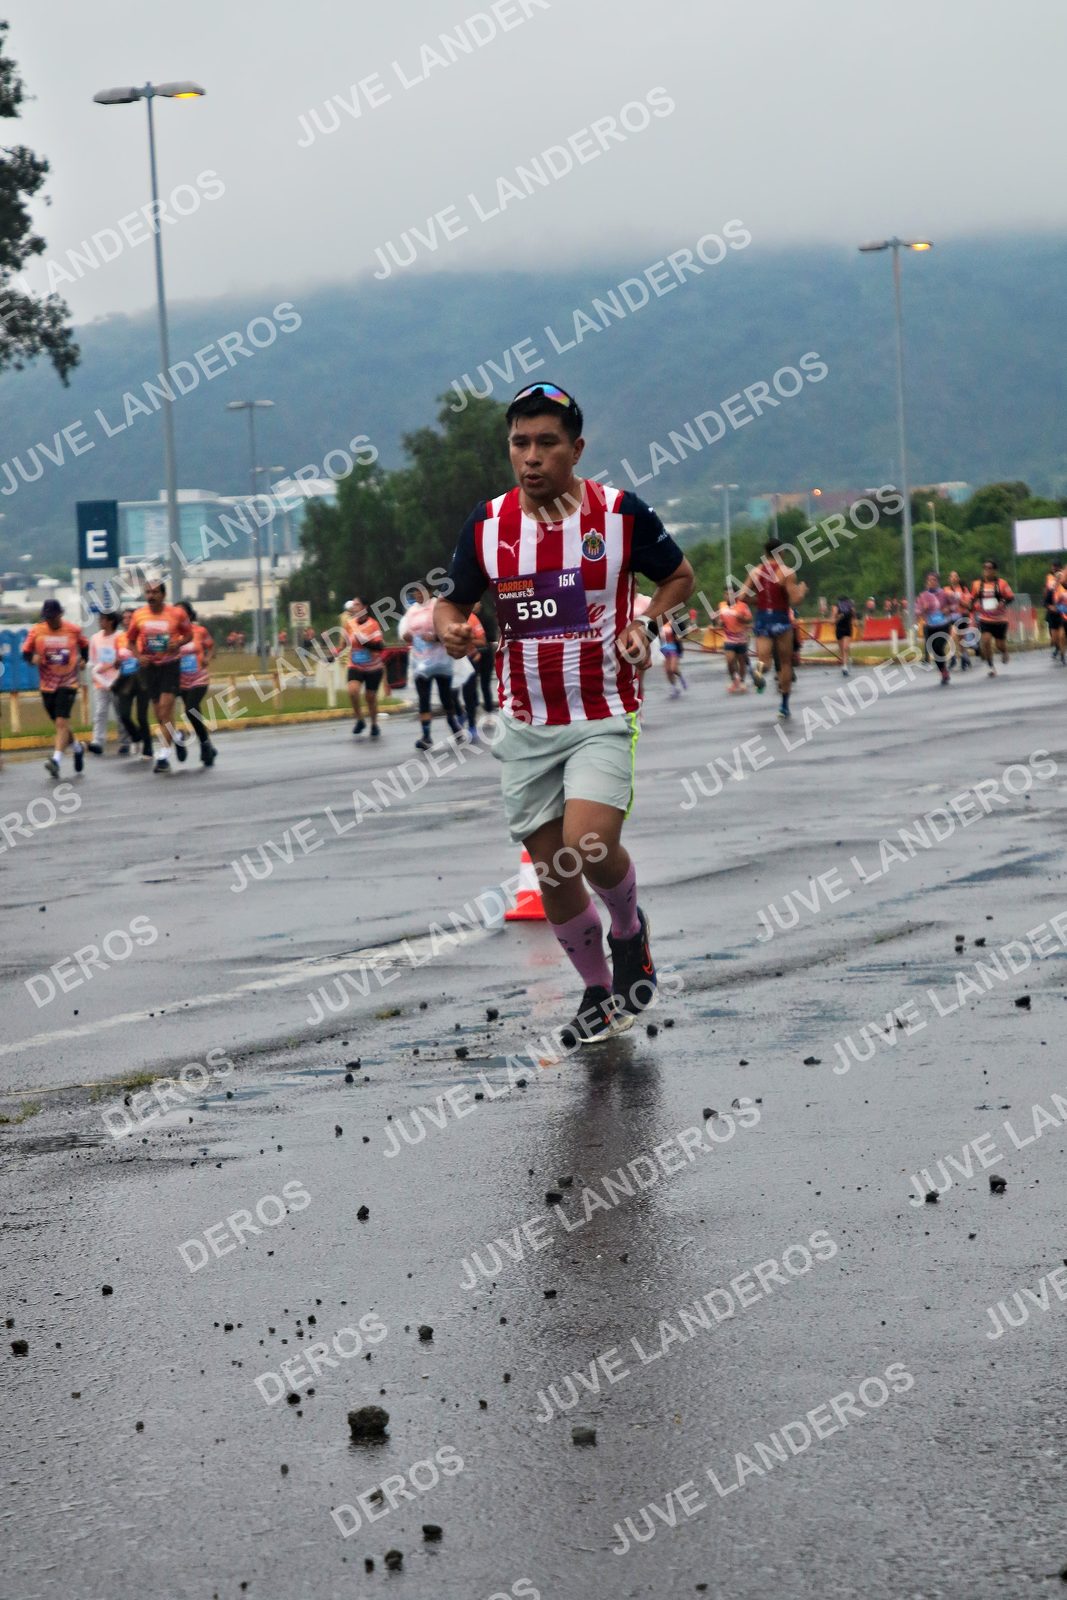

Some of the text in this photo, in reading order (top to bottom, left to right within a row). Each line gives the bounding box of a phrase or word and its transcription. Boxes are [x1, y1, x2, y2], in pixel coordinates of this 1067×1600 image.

[86, 529, 109, 559] E
[497, 579, 534, 592] CARRERA
[499, 592, 527, 600] OMNILIFE
[516, 599, 558, 620] 530
